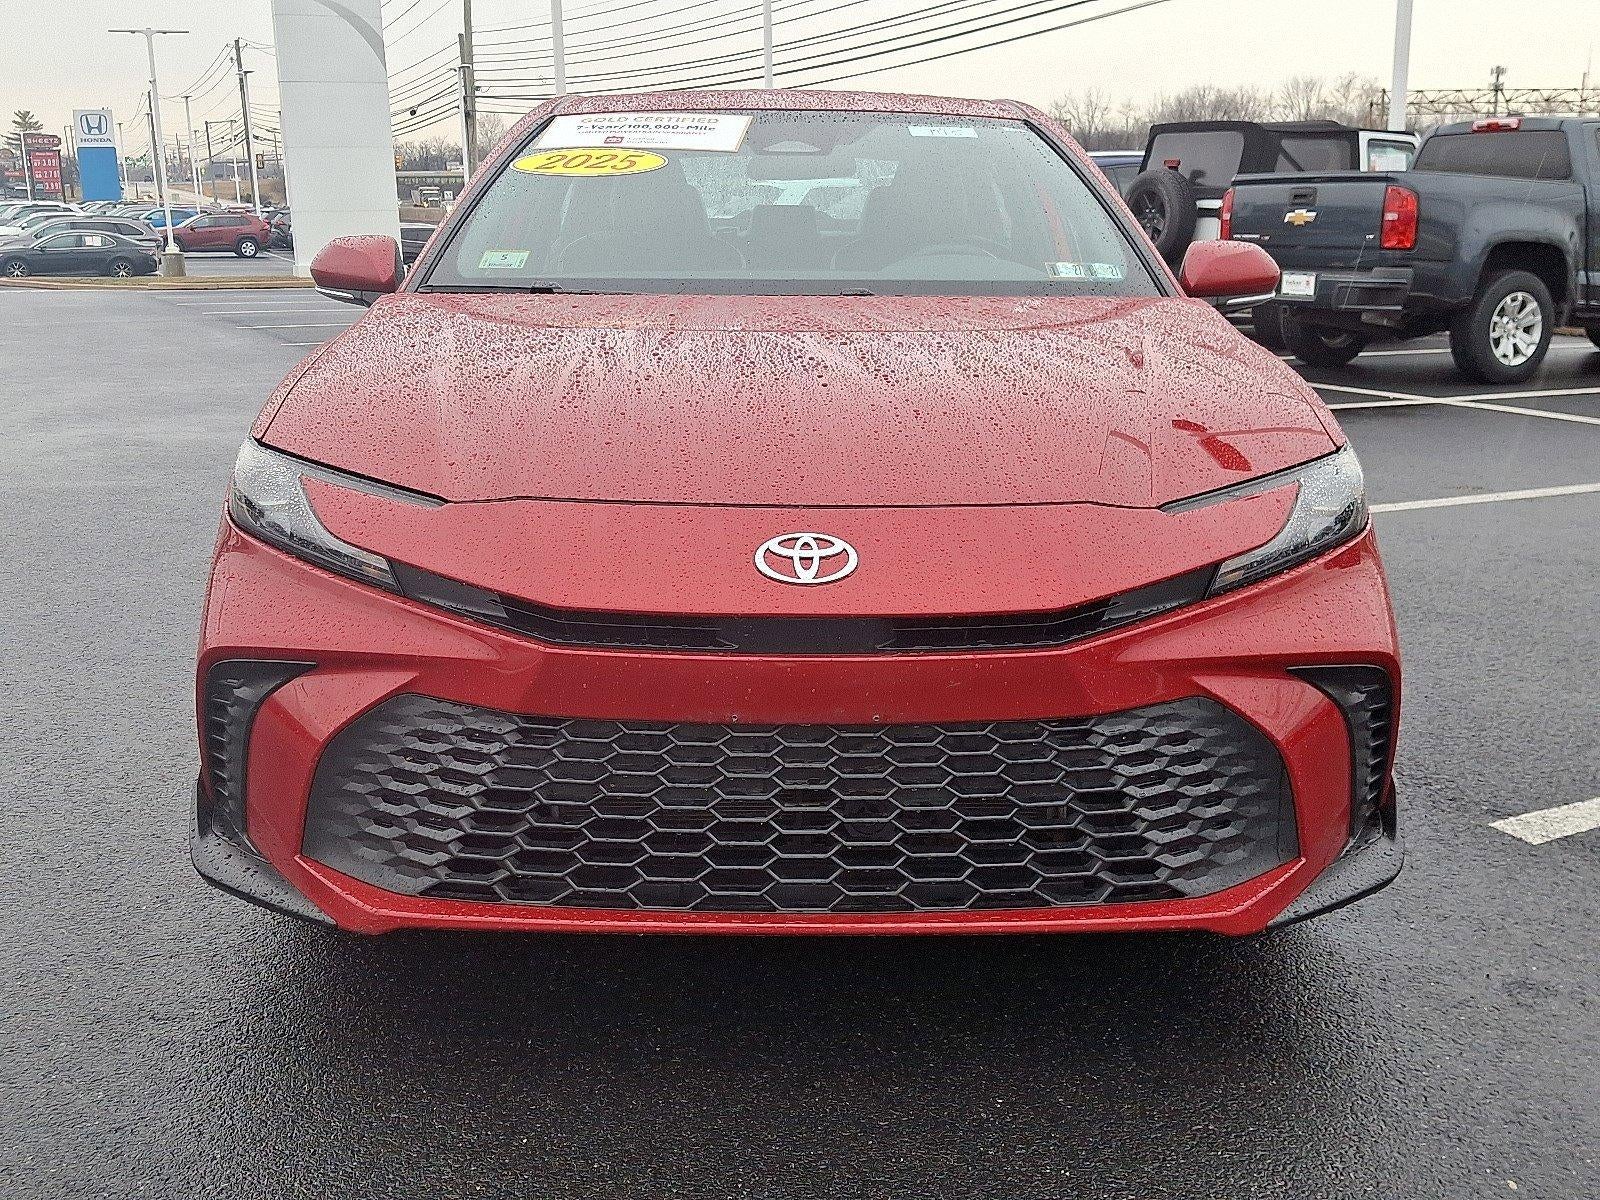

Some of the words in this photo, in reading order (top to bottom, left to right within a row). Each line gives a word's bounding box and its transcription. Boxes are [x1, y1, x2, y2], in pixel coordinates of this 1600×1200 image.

[581, 116, 629, 124] GOLD
[633, 116, 719, 124] CERTIFIED
[534, 153, 646, 171] 2025
